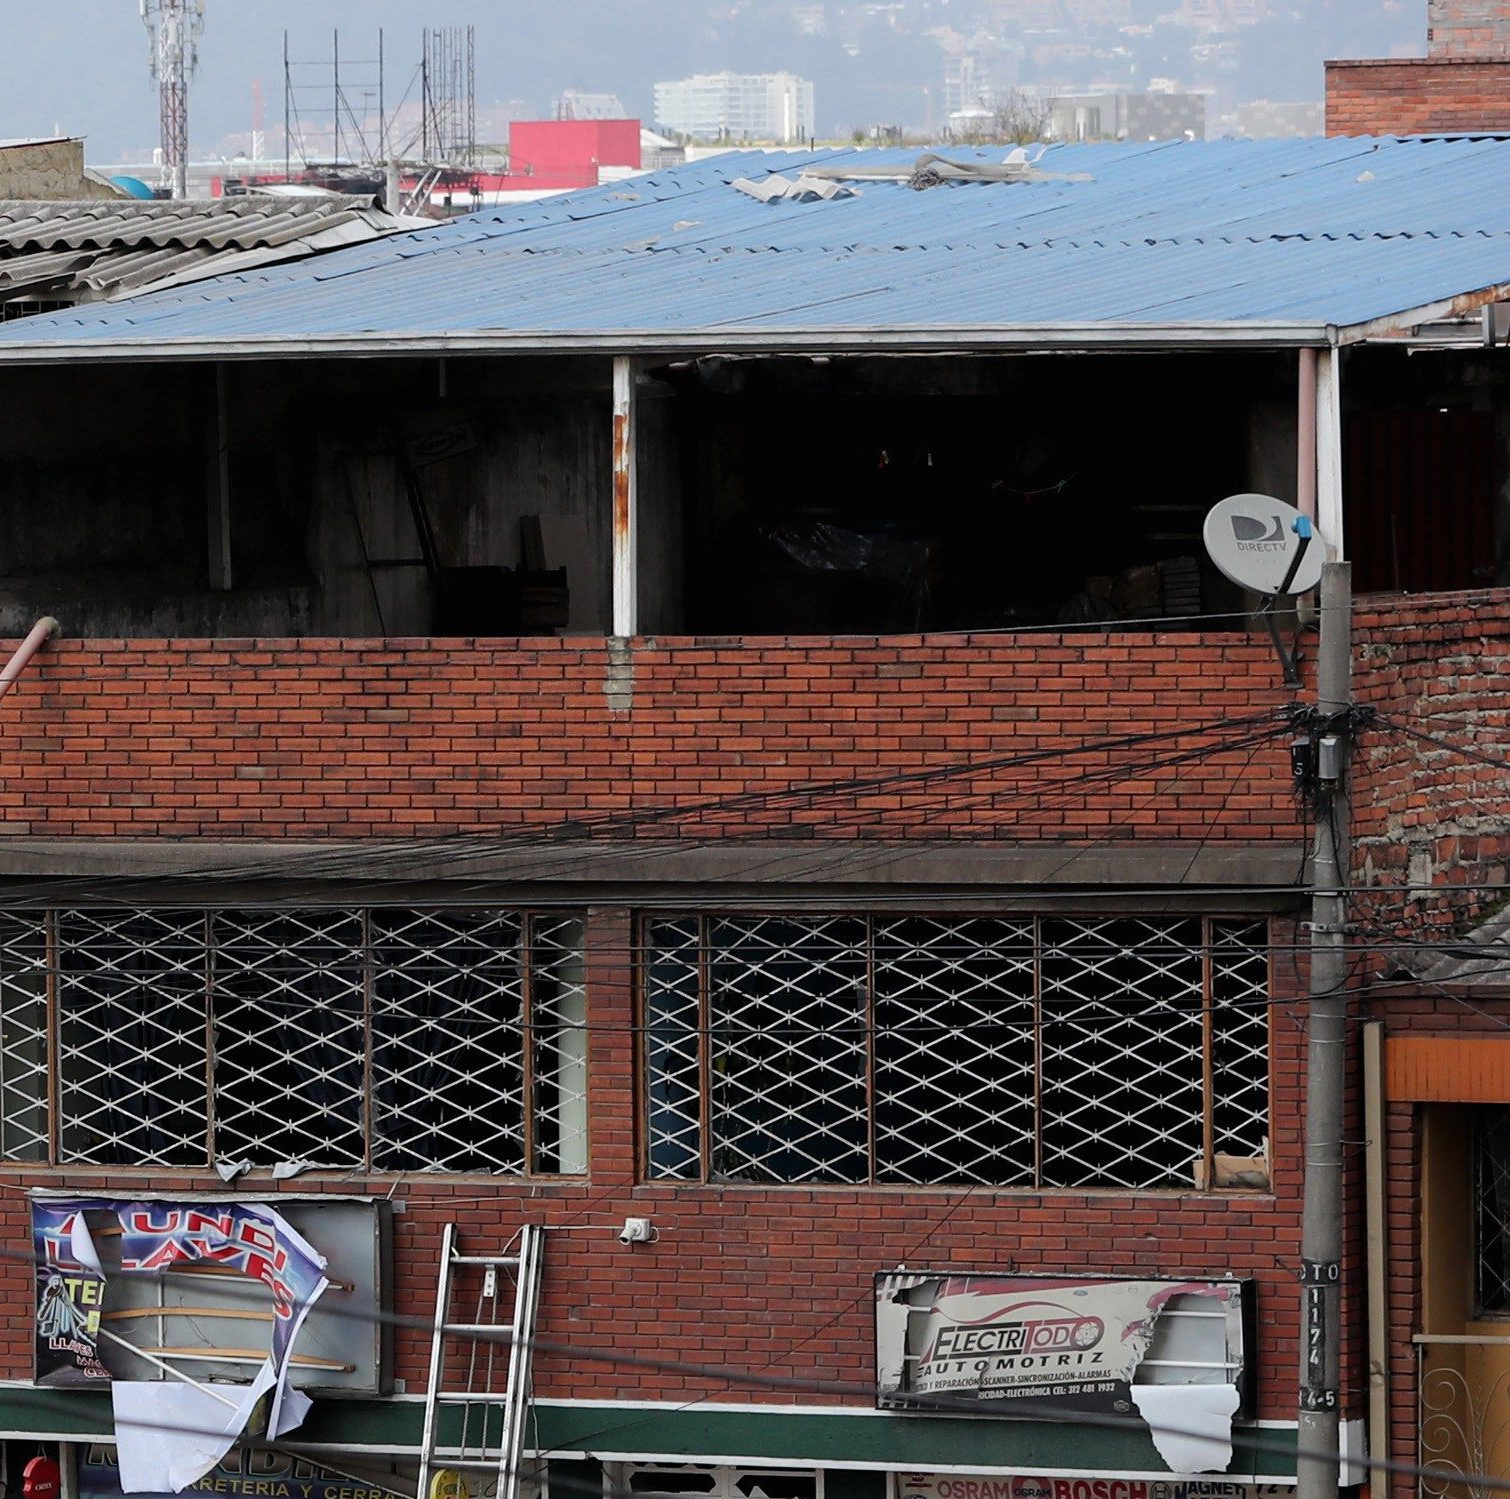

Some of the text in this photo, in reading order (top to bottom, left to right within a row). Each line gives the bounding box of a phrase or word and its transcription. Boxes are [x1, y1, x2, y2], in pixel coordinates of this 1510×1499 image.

[1237, 541, 1287, 552] DIRECTV
[923, 1351, 1105, 1377] AUTOMOTRIZ
[1068, 1385, 1080, 1395] 312
[1097, 1382, 1115, 1393] 1932
[300, 1486, 311, 1499] Y
